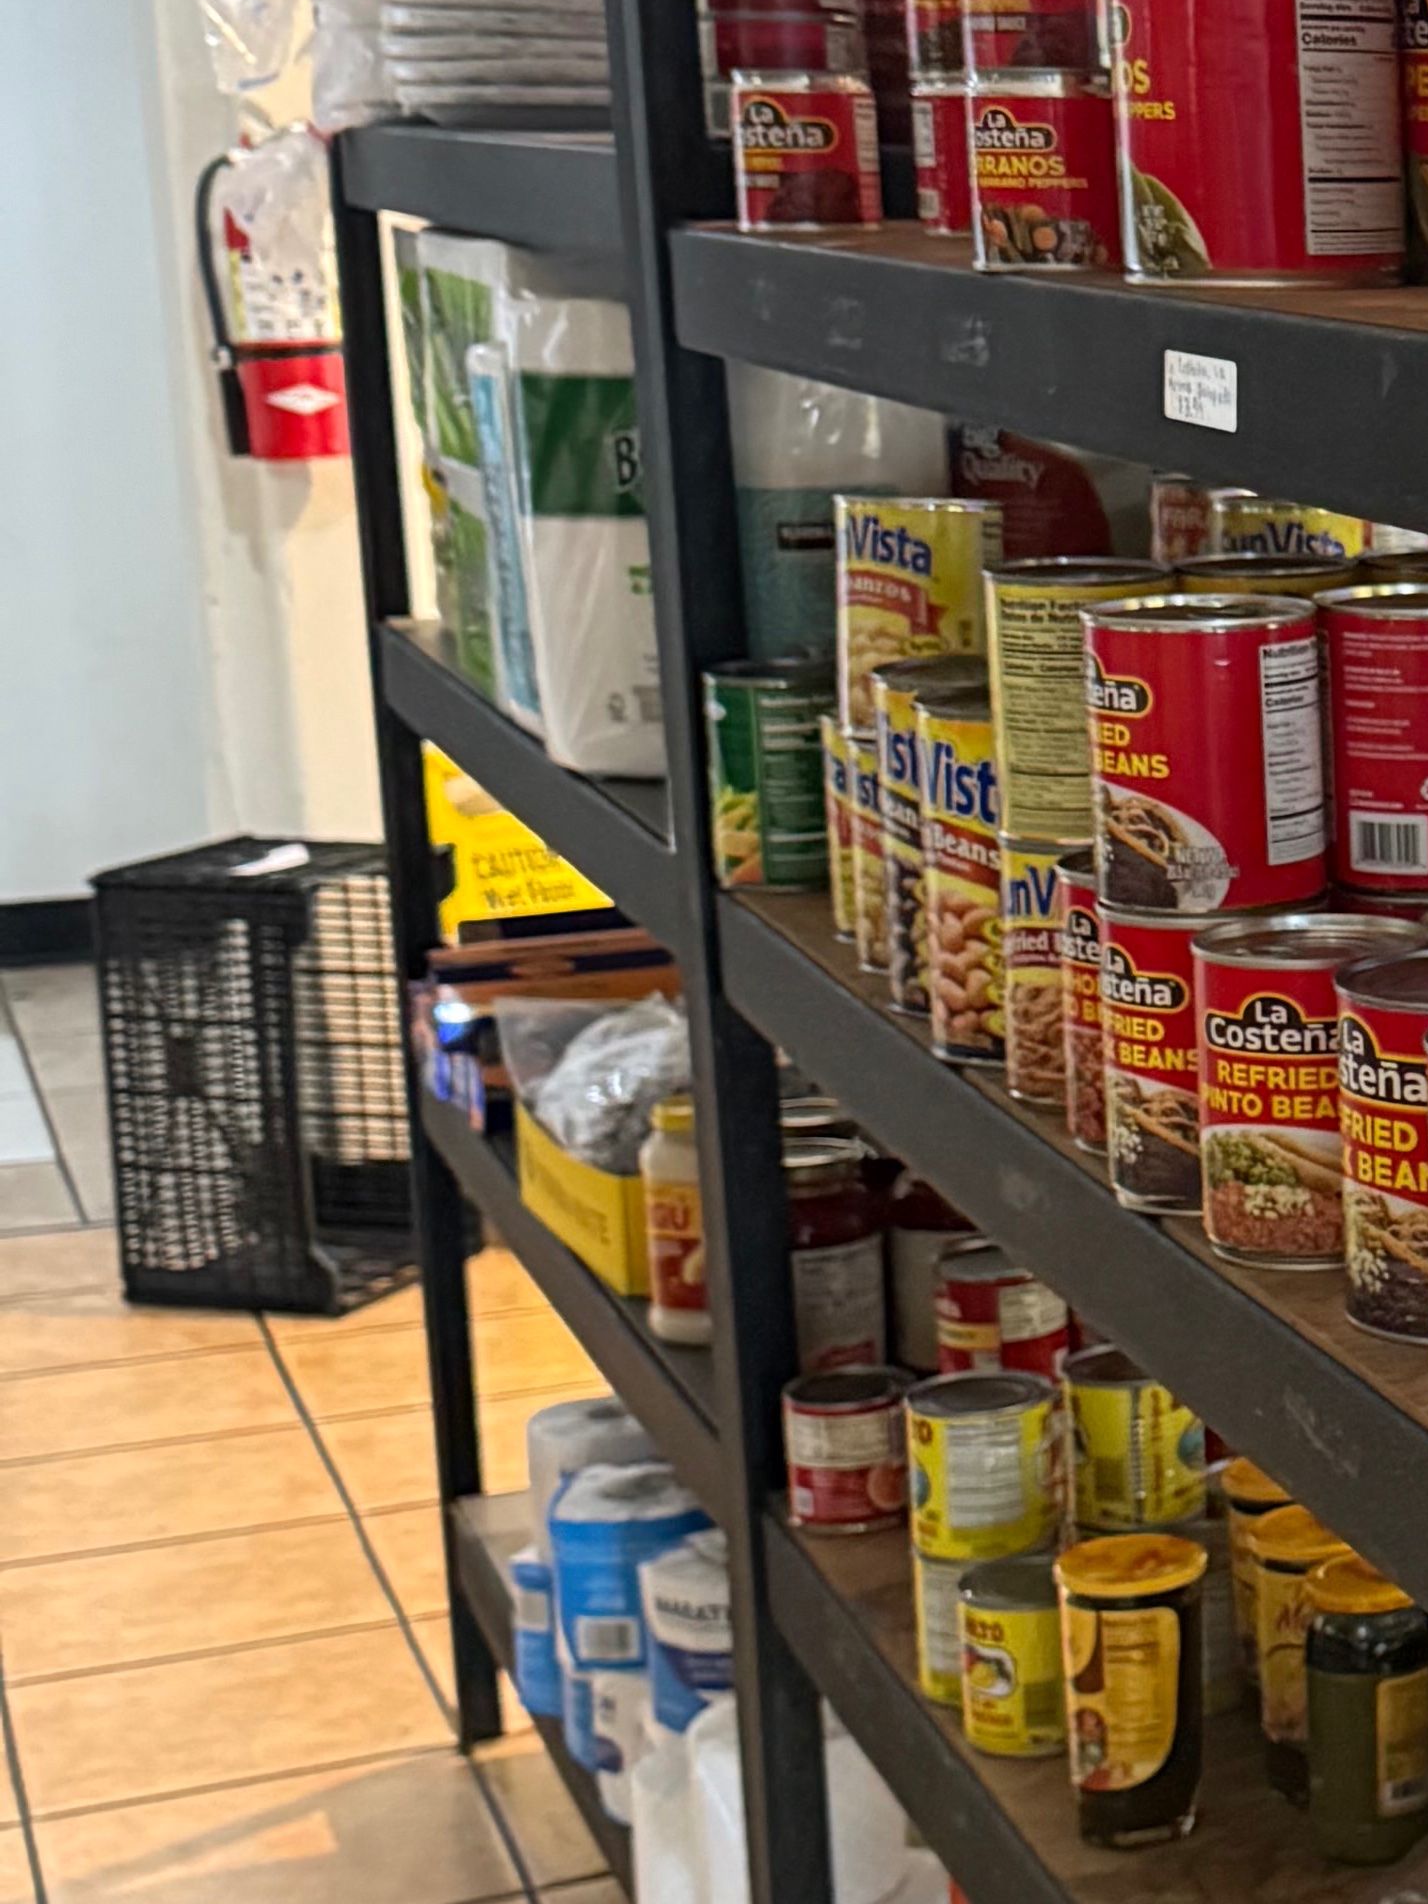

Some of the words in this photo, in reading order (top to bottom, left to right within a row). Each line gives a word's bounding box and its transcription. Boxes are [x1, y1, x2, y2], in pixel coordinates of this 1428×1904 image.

[1301, 30, 1358, 48] Calories
[1254, 998, 1288, 1026] La
[1217, 1060, 1338, 1091] REFRIED
